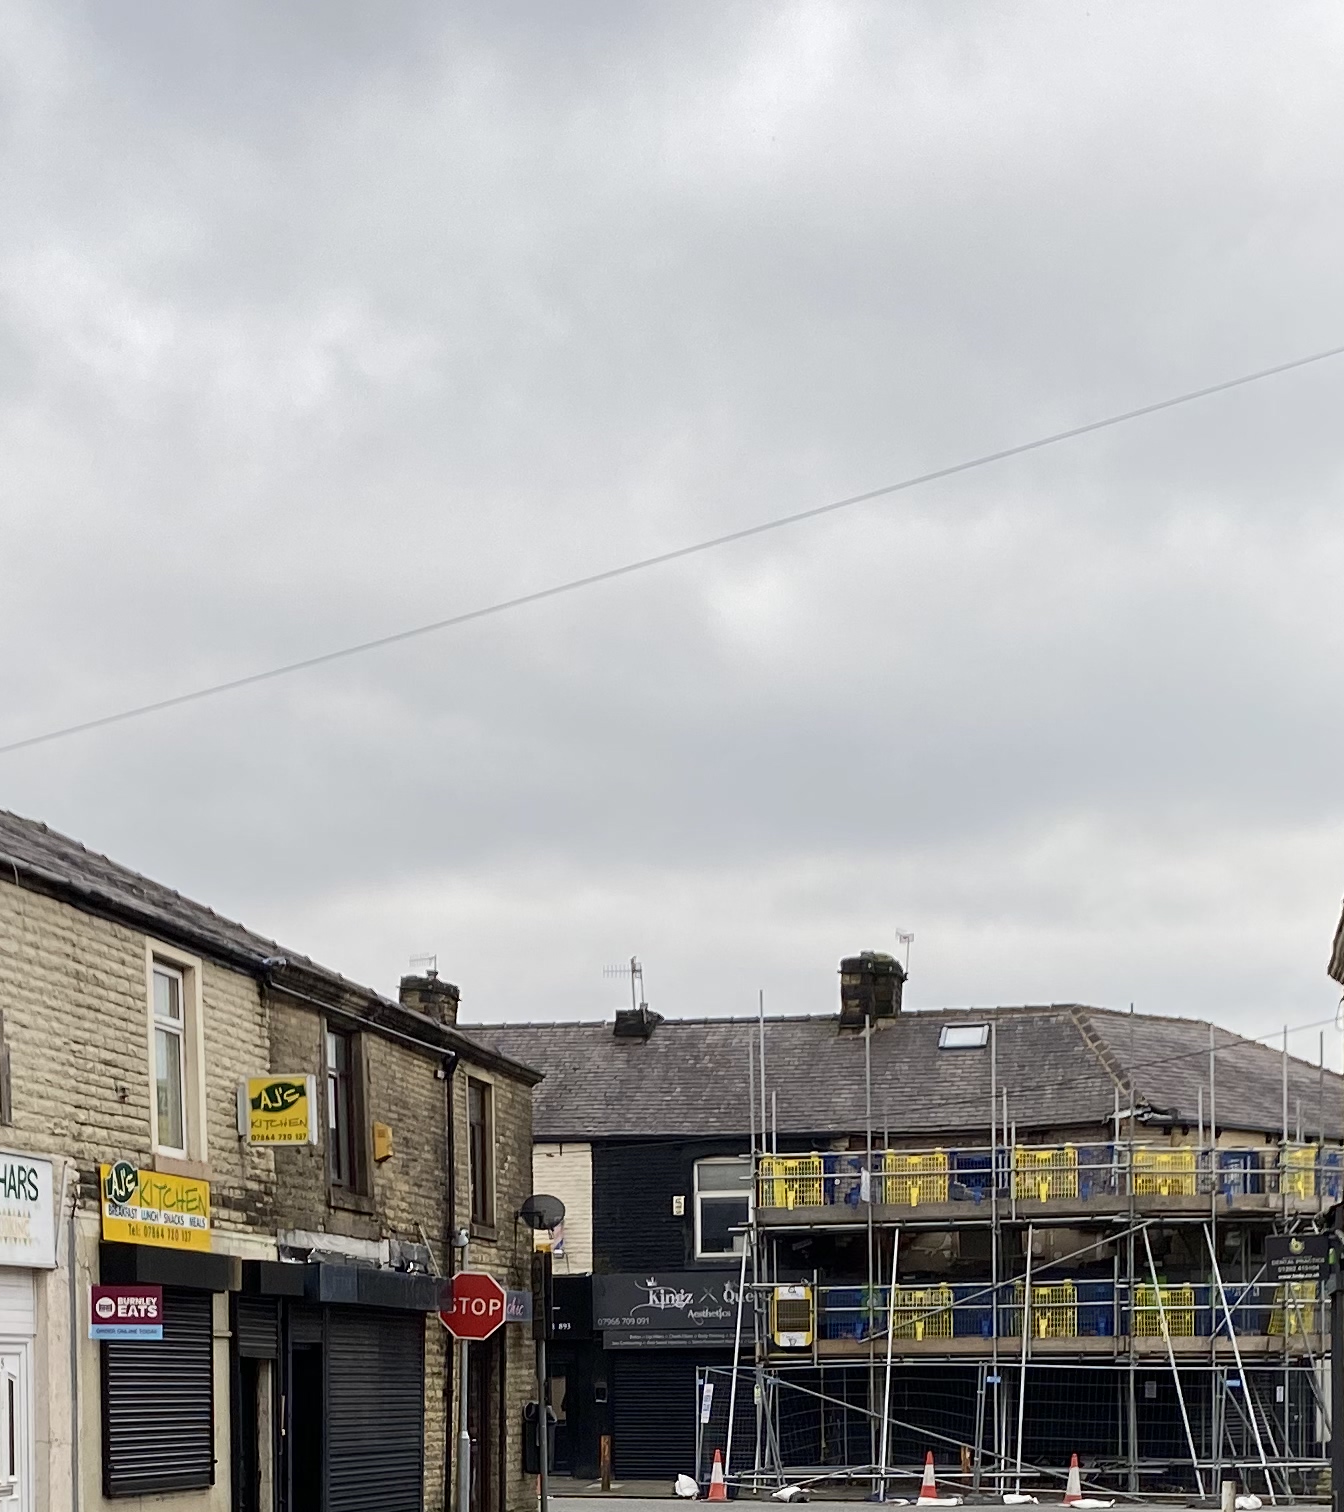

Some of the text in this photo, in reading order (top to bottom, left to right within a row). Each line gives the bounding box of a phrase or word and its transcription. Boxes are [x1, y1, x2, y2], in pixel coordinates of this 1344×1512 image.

[251, 1117, 307, 1130] KITCHEN
[139, 1179, 207, 1218] KITCHEN
[108, 1203, 206, 1228] BREAKFAST LUNCH SNACKS MEALS
[117, 1297, 157, 1305] BURNLEY
[117, 1305, 158, 1318] EATS
[622, 1318, 636, 1326] 709
